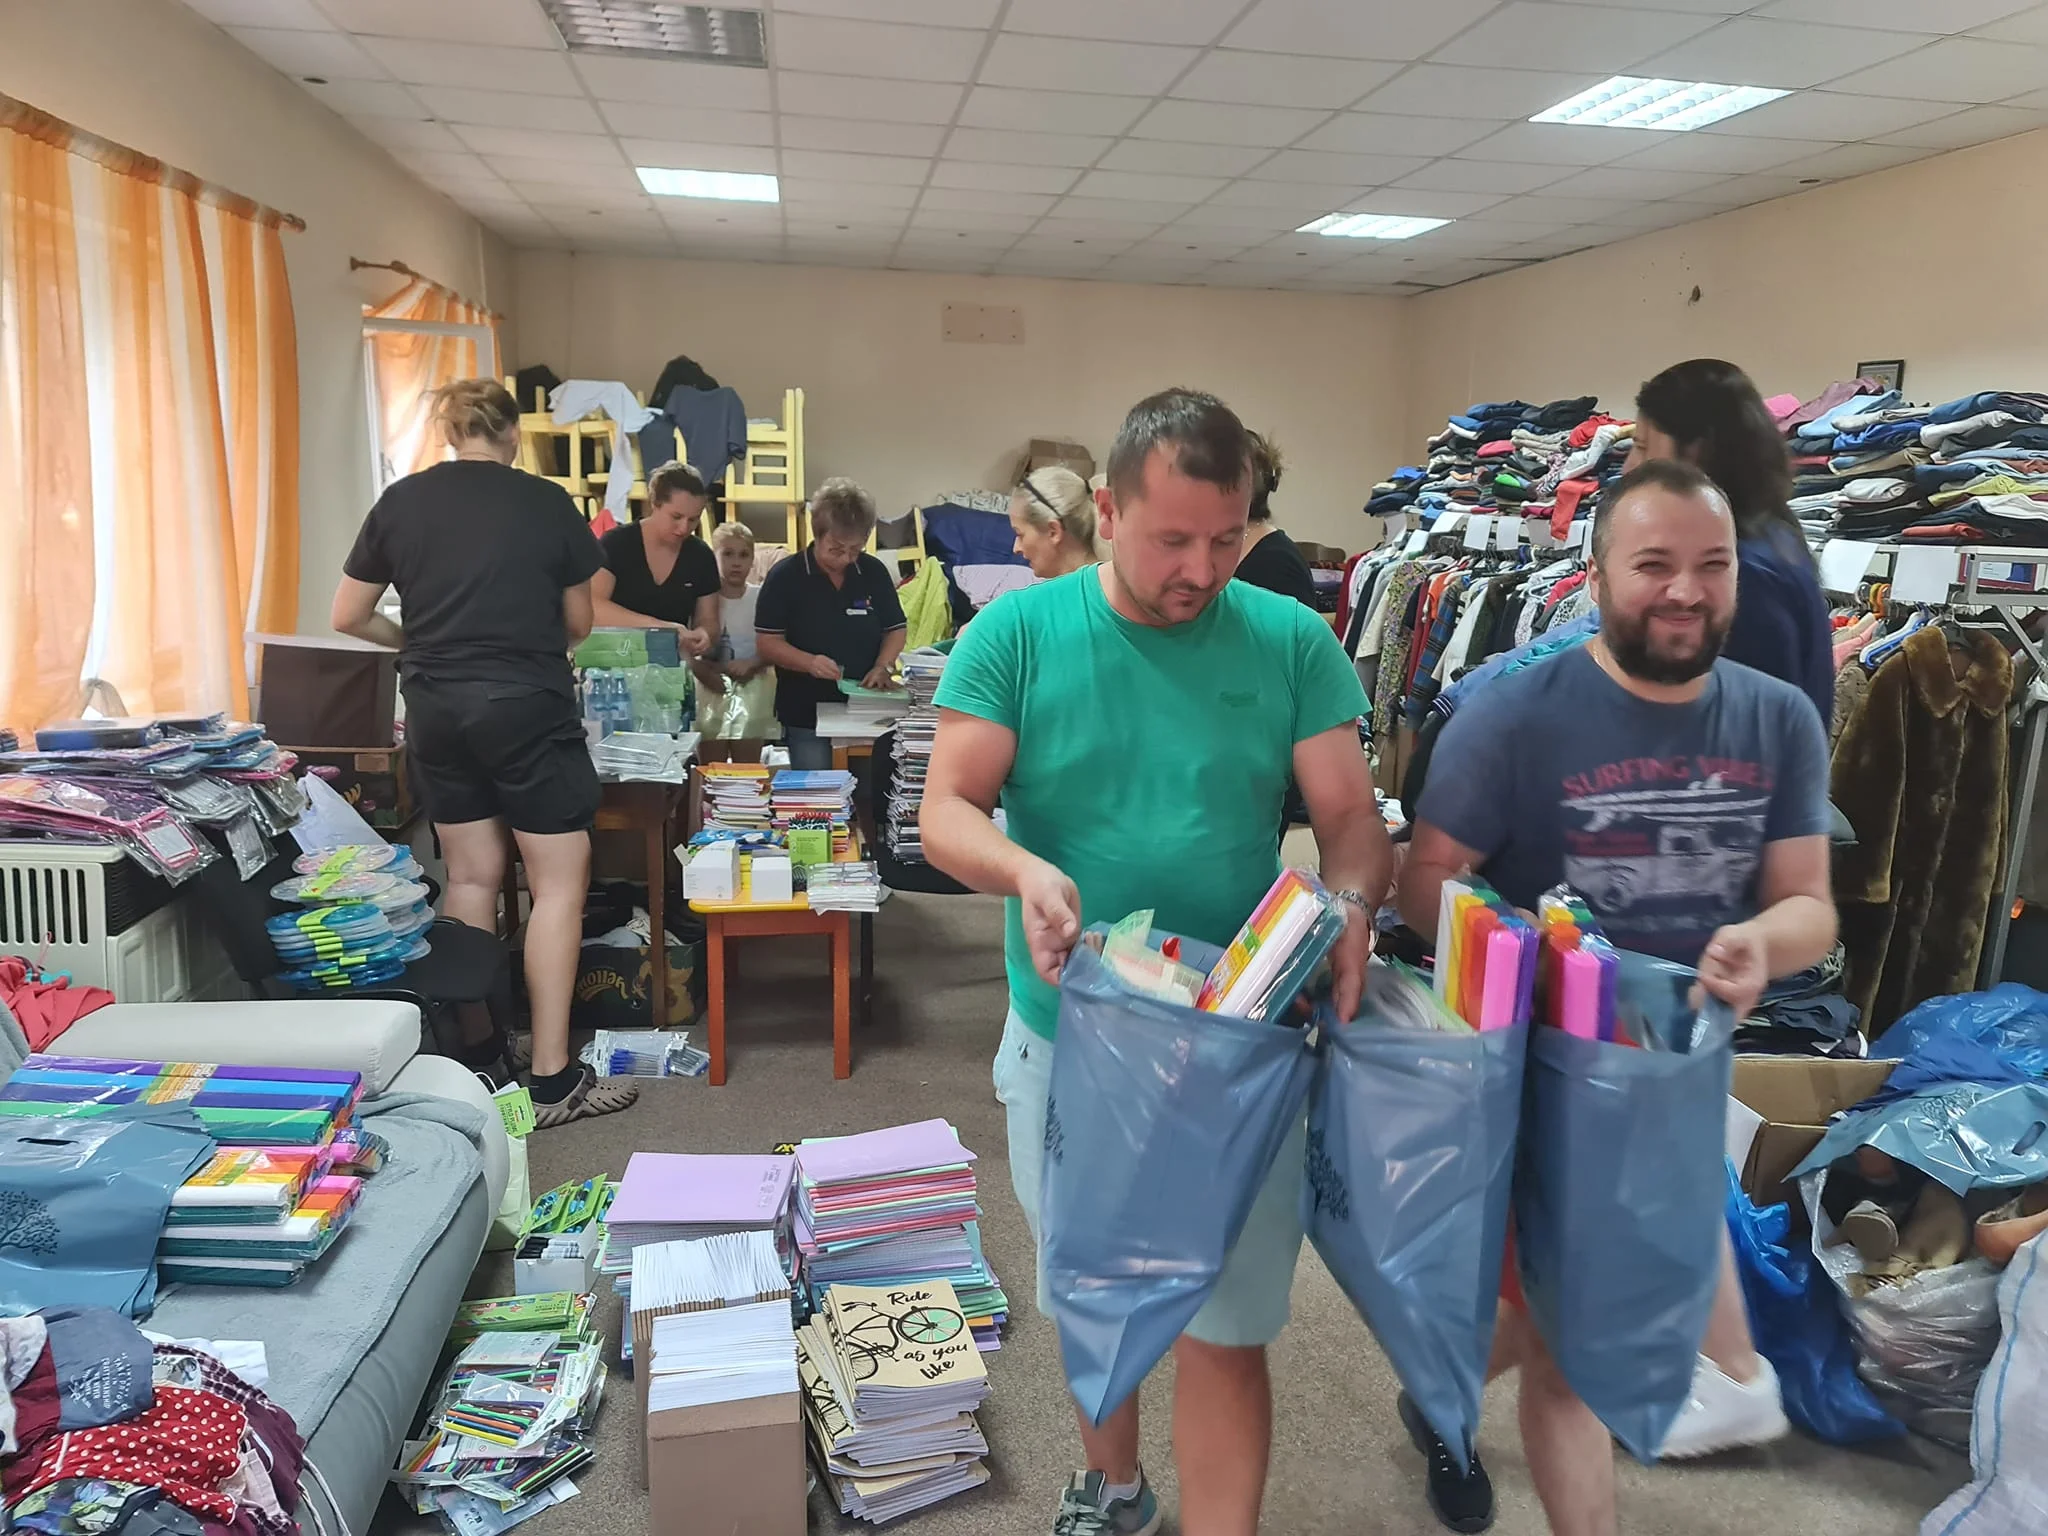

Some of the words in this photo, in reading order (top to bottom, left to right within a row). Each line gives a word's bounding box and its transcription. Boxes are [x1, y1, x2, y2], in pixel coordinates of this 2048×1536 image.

[1561, 756, 1690, 799] SURFING
[886, 1291, 932, 1305] Ride
[903, 1351, 925, 1361] as
[932, 1344, 968, 1360] you
[920, 1360, 955, 1379] like
